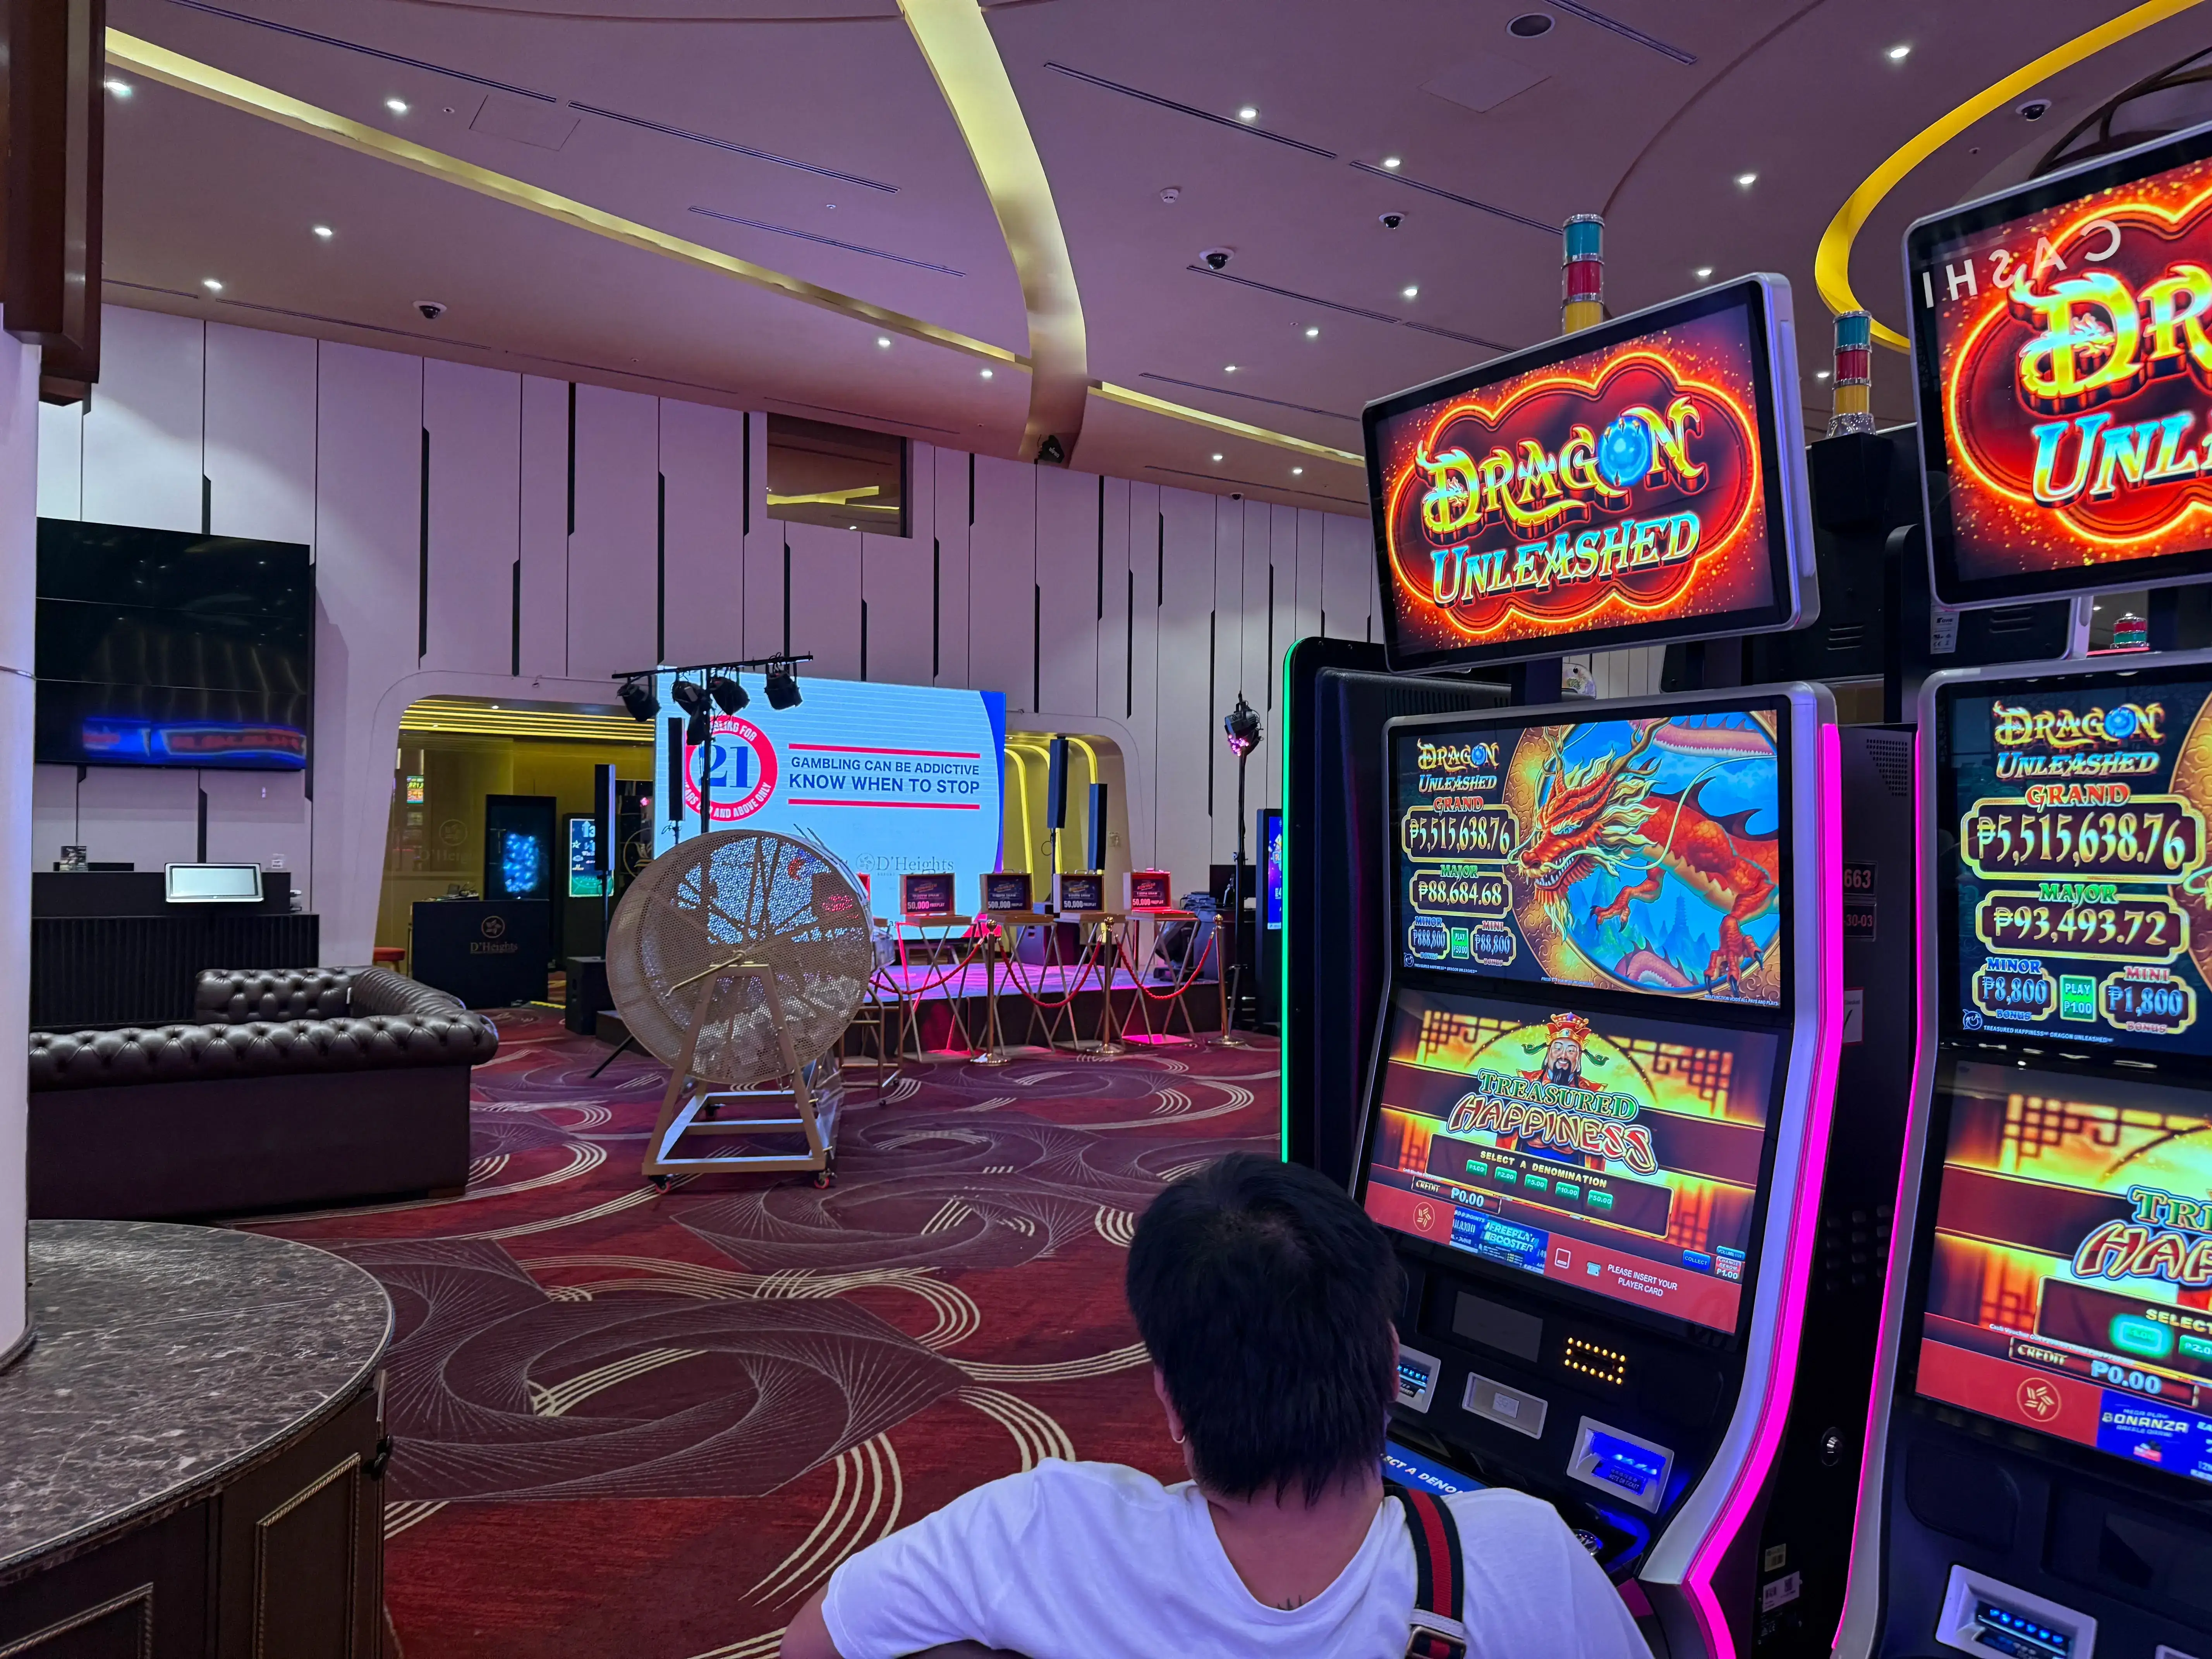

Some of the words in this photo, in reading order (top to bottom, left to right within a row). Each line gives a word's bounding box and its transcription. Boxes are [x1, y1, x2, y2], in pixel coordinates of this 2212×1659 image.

[1415, 395, 1707, 536] DRAGON
[2031, 411, 2212, 503] UNL
[1431, 511, 1700, 605] UNLEASHED
[739, 725, 757, 742] FOR
[1992, 701, 2166, 749] DRAGON
[1417, 738, 1499, 772] DRAGON
[699, 744, 752, 788] 21
[791, 756, 860, 771] GAMBLING
[864, 760, 891, 772] CAN
[895, 761, 911, 773] BE
[914, 762, 979, 775] ADDICTIVE
[1996, 751, 2161, 780] UNLEASHED
[789, 773, 846, 790] KNOW
[851, 776, 903, 792] WHEN
[908, 778, 932, 793] TO
[936, 779, 980, 795] STOP
[1419, 774, 1498, 793] UNLEASHED
[713, 807, 731, 818] AND
[733, 798, 759, 818] ABOVE
[755, 781, 772, 802] ONLY
[1433, 796, 1484, 816] GRAND
[2025, 783, 2131, 812] GRAND
[876, 856, 954, 872] D'Heights
[1440, 864, 1479, 883] MAJOR
[1844, 869, 1871, 888] 663
[988, 900, 1011, 909] 500,000
[1063, 900, 1083, 908] 50,000
[2039, 883, 2119, 908] MAJOR
[907, 901, 929, 910] 50,000
[1415, 916, 1443, 928] MINOR
[1482, 920, 1504, 933] MINI
[1455, 933, 1465, 941] PLAY
[1985, 957, 2042, 975] MINOR
[2124, 966, 2171, 984] MINI
[2065, 983, 2090, 995] PLAY
[1996, 1009, 2032, 1021] BONUS
[1984, 1025, 2014, 1034] TREASURED
[2126, 1021, 2167, 1034] BONUS
[1478, 1069, 1638, 1120] TREASURED
[1447, 1094, 1658, 1175] HAPPINESS
[1480, 1151, 1515, 1165] SELECT
[1520, 1160, 1527, 1169] A
[1532, 1163, 1607, 1188] DENOMINATION
[1415, 1180, 1440, 1193] CREDIT
[1685, 1256, 1707, 1266] COLLECT
[1719, 1257, 1739, 1266] CHANGE
[1719, 1262, 1738, 1271] DENOM
[1607, 1264, 1633, 1278] PLEASE
[1633, 1271, 1657, 1285] INSERT
[1658, 1278, 1678, 1291] YOUR
[1618, 1277, 1644, 1291] PLAYER
[1644, 1285, 1664, 1297] CARD
[2017, 1344, 2068, 1366] CREDIT
[2102, 1412, 2189, 1434] BONANZA
[1405, 1467, 1417, 1475] A
[1418, 1472, 1463, 1494] DENO
